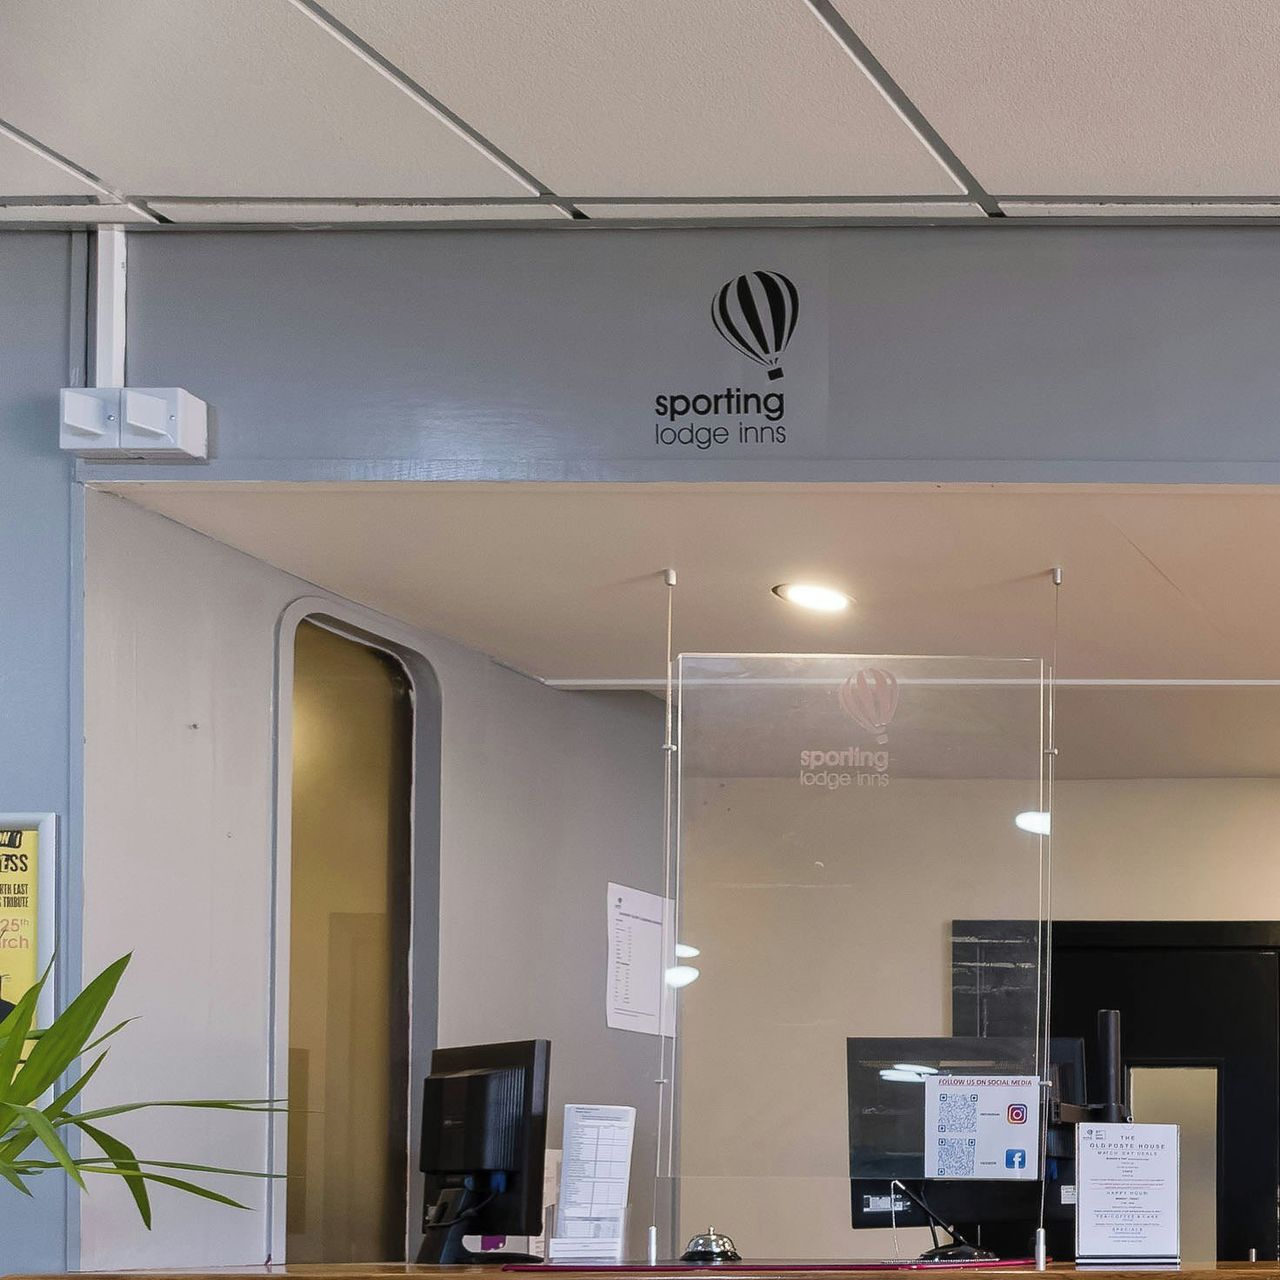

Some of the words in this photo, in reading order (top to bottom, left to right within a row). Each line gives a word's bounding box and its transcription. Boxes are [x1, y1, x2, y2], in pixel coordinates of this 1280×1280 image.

[655, 387, 785, 421] sporting
[655, 423, 730, 450] lodge
[739, 422, 787, 444] inns
[800, 746, 890, 772] sporting
[800, 770, 852, 791] lodge
[857, 771, 890, 787] inns
[13, 883, 29, 895] EAST
[938, 1078, 966, 1087] FOLLOW
[966, 1078, 976, 1087] US
[976, 1078, 987, 1087] ON
[987, 1079, 1009, 1087] SOCIAL
[1010, 1079, 1033, 1087] MEDIA
